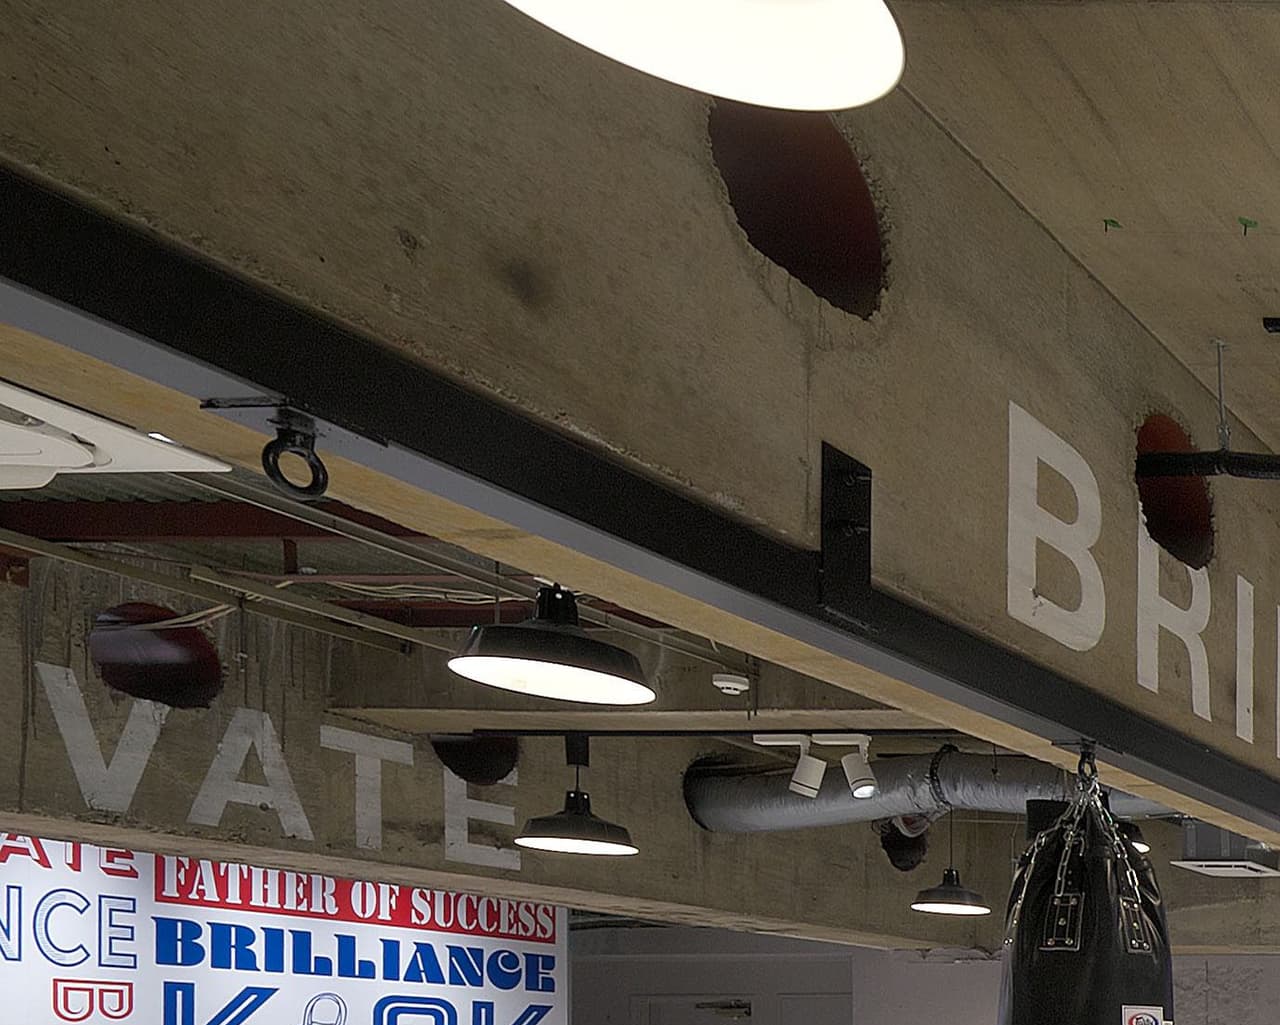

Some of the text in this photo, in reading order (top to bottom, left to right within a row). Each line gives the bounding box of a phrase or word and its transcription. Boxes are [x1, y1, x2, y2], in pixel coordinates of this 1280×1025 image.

[162, 856, 555, 939] FATHER OF SUCCESS
[151, 917, 556, 992] BRILLIANCE
